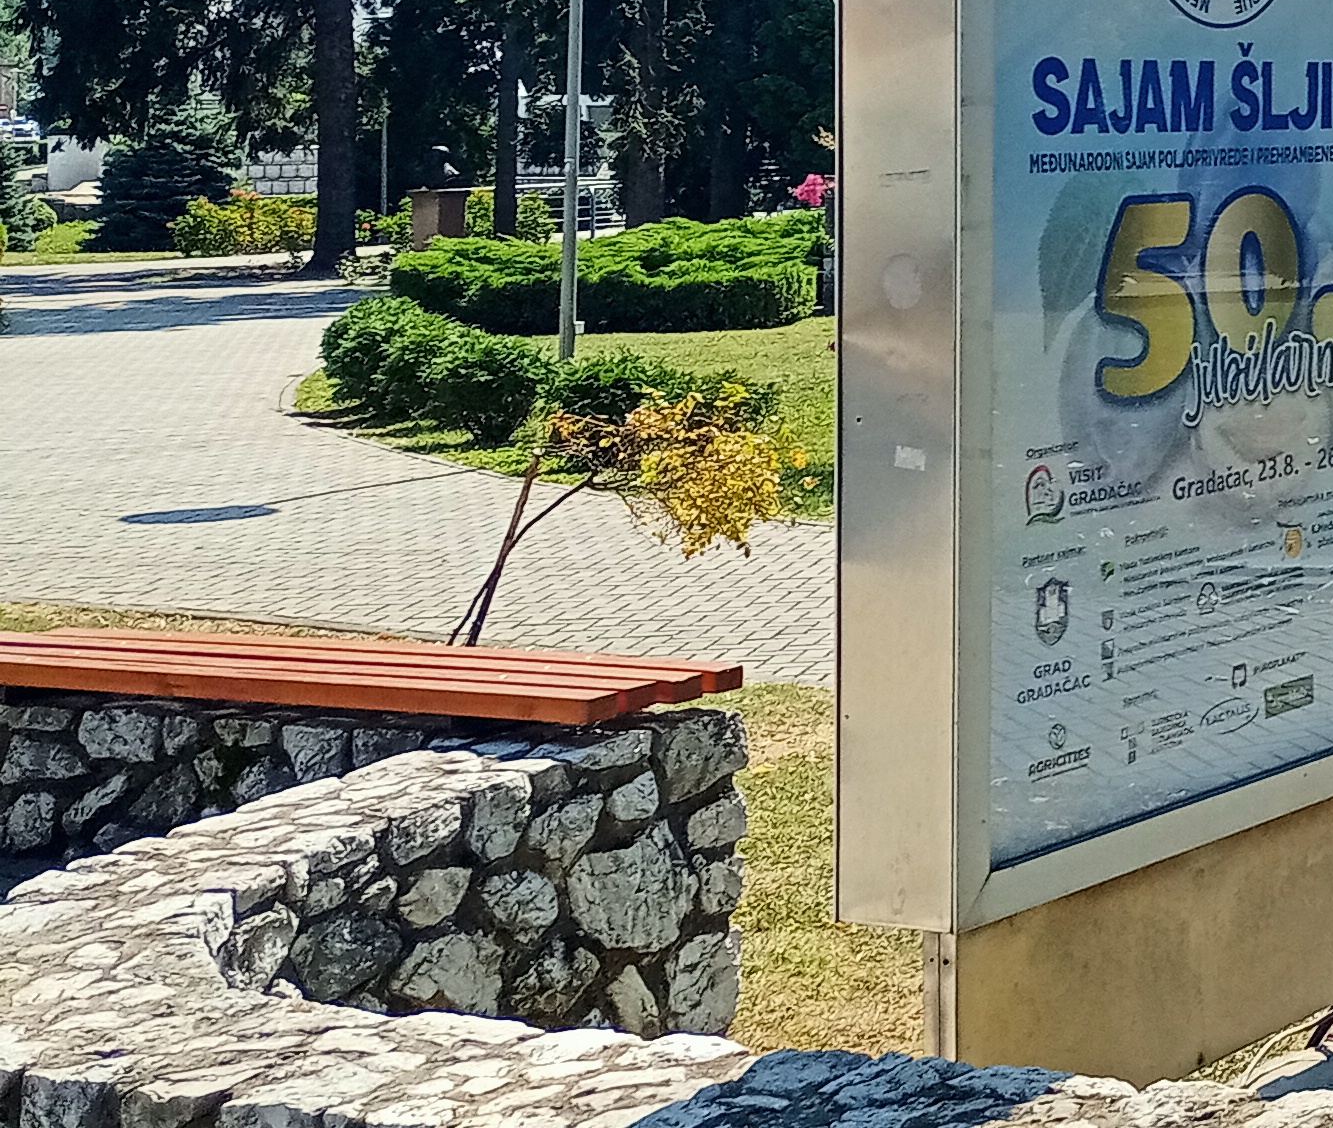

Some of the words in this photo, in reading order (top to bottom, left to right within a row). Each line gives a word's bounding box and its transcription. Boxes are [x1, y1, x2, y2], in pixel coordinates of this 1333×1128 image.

[1031, 56, 1216, 136] SAJAM
[1029, 150, 1124, 174] MEĐUNARODNI
[1125, 150, 1157, 171] SAJAM
[1157, 146, 1250, 169] POLJOPRIVREDE
[1068, 465, 1104, 485] VISIT
[1172, 465, 1254, 501] Gradačac,
[1257, 453, 1300, 483] 23.8.
[1068, 481, 1143, 507] GRADAČAC
[1033, 659, 1072, 680] GRAD
[1016, 675, 1092, 704] GRADAČAC
[1205, 703, 1251, 726] LACTALIS
[1027, 746, 1091, 777] AGRICITIES
